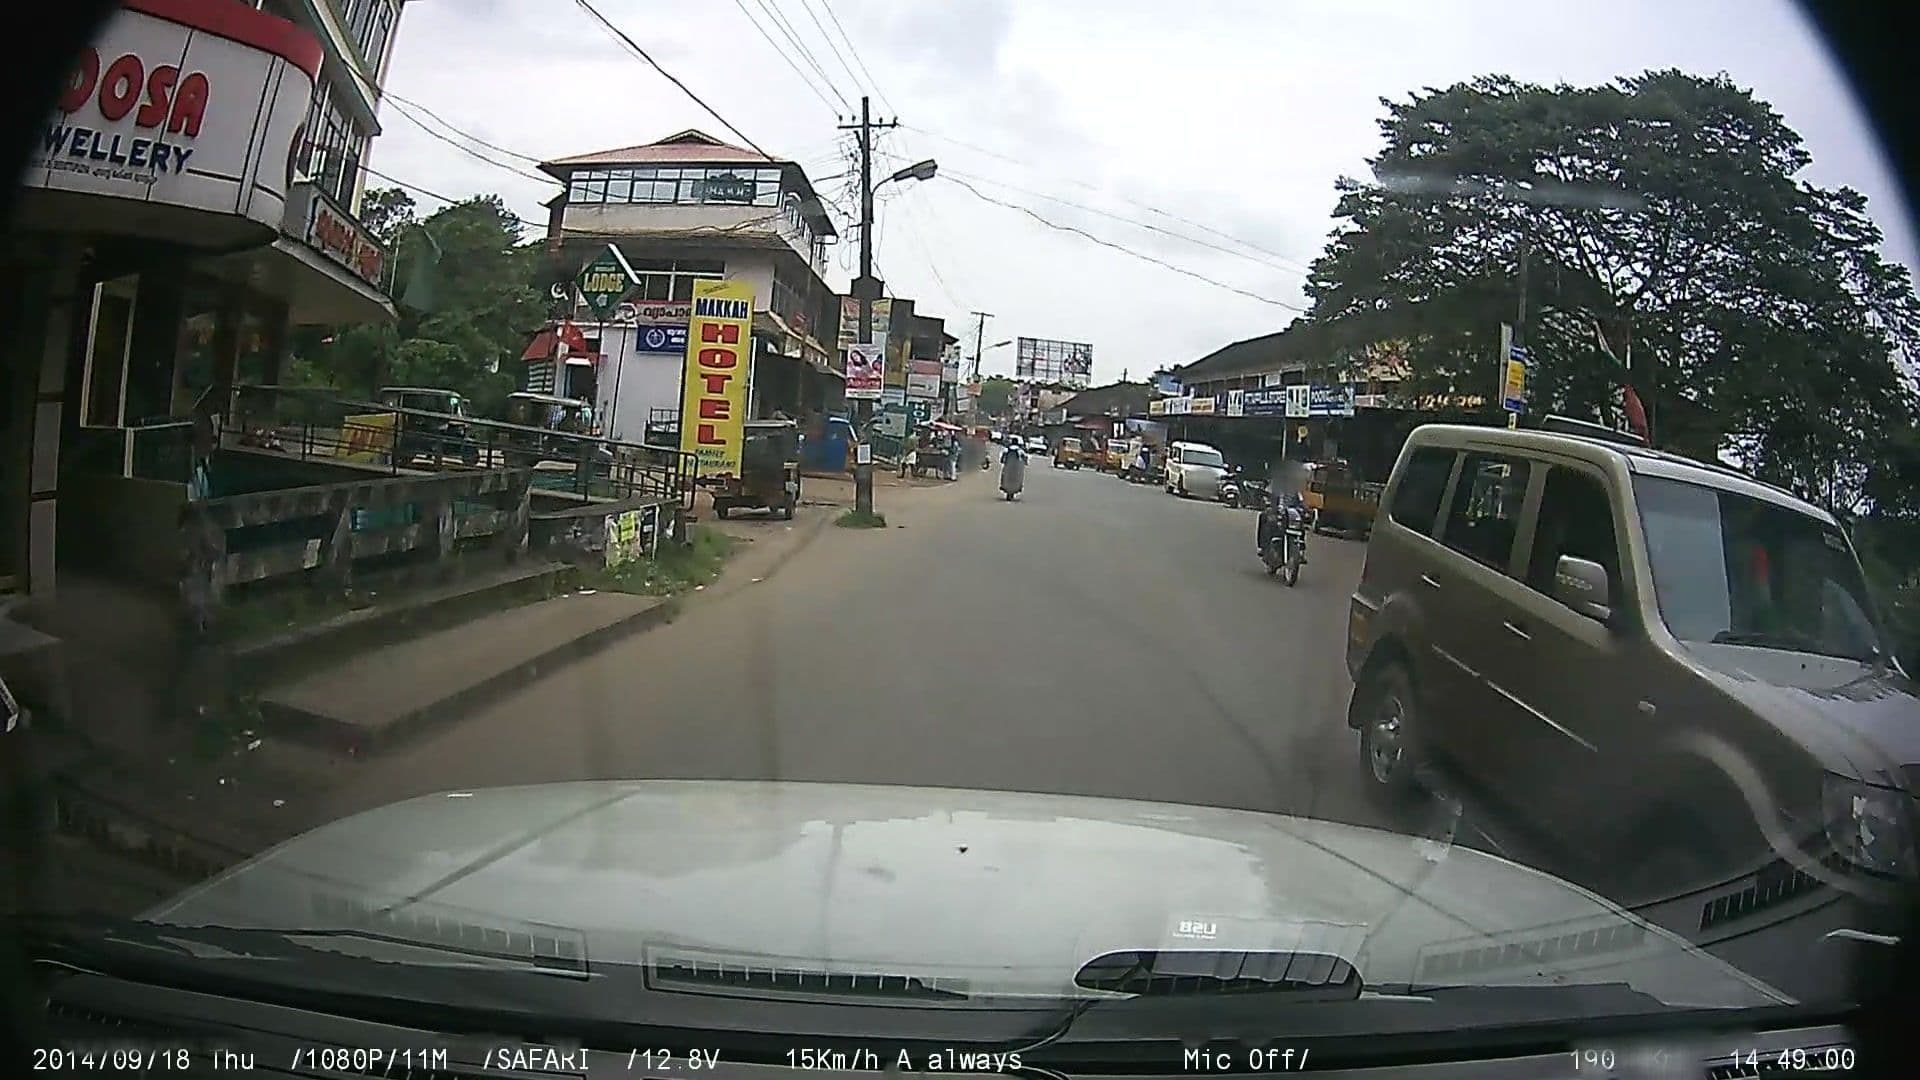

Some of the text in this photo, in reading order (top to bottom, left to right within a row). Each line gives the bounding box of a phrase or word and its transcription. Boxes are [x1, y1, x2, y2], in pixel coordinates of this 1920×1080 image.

[583, 273, 625, 293] LODGE
[695, 298, 749, 320] MAKKAH
[698, 322, 740, 445] HOTEL
